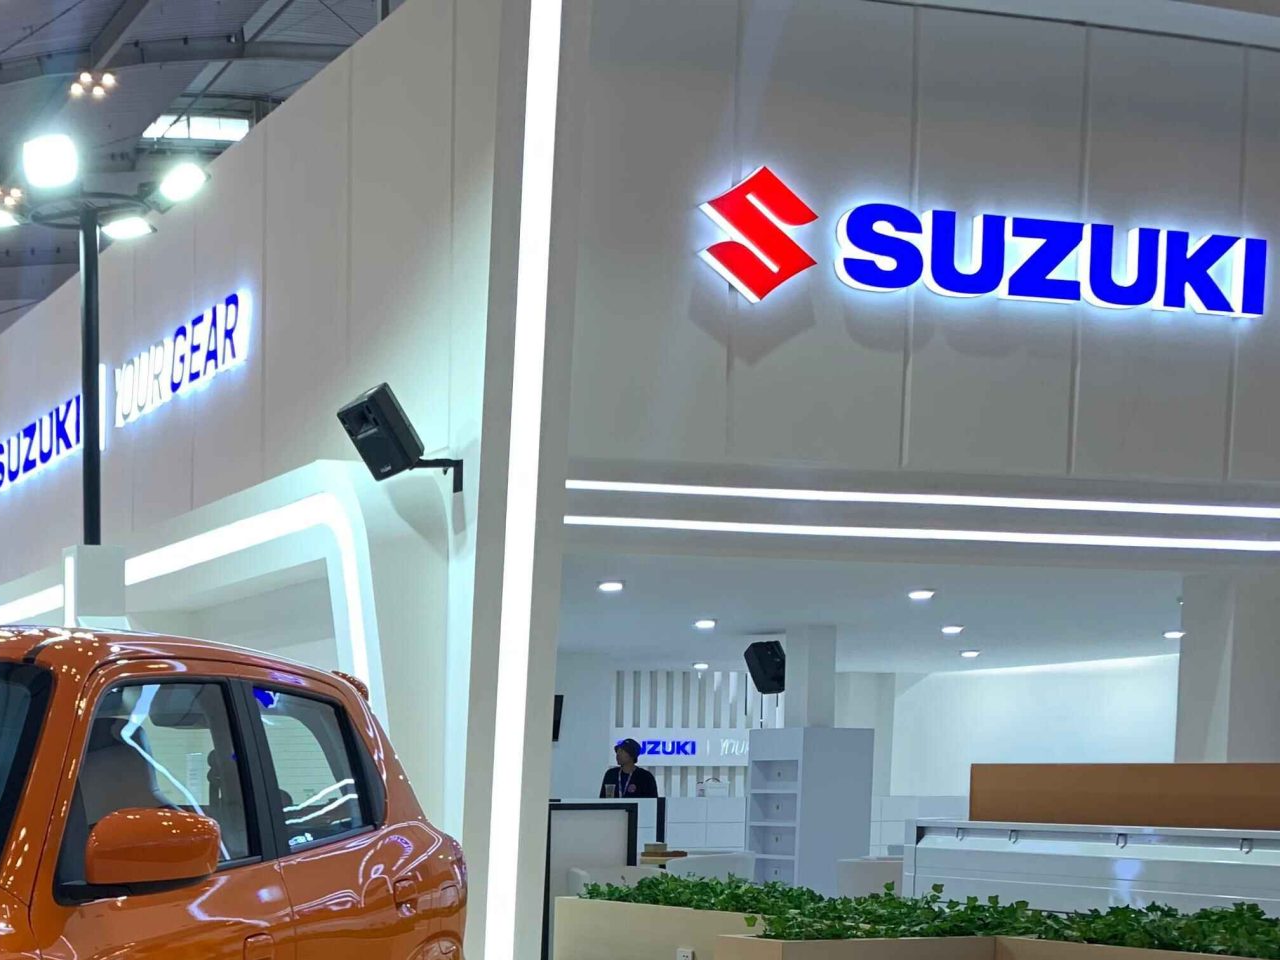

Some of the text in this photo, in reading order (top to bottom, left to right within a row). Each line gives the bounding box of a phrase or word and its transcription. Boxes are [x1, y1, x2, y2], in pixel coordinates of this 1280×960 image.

[836, 203, 1268, 316] SUZUKI
[114, 339, 166, 428] YOUR
[170, 293, 240, 393] GEAR
